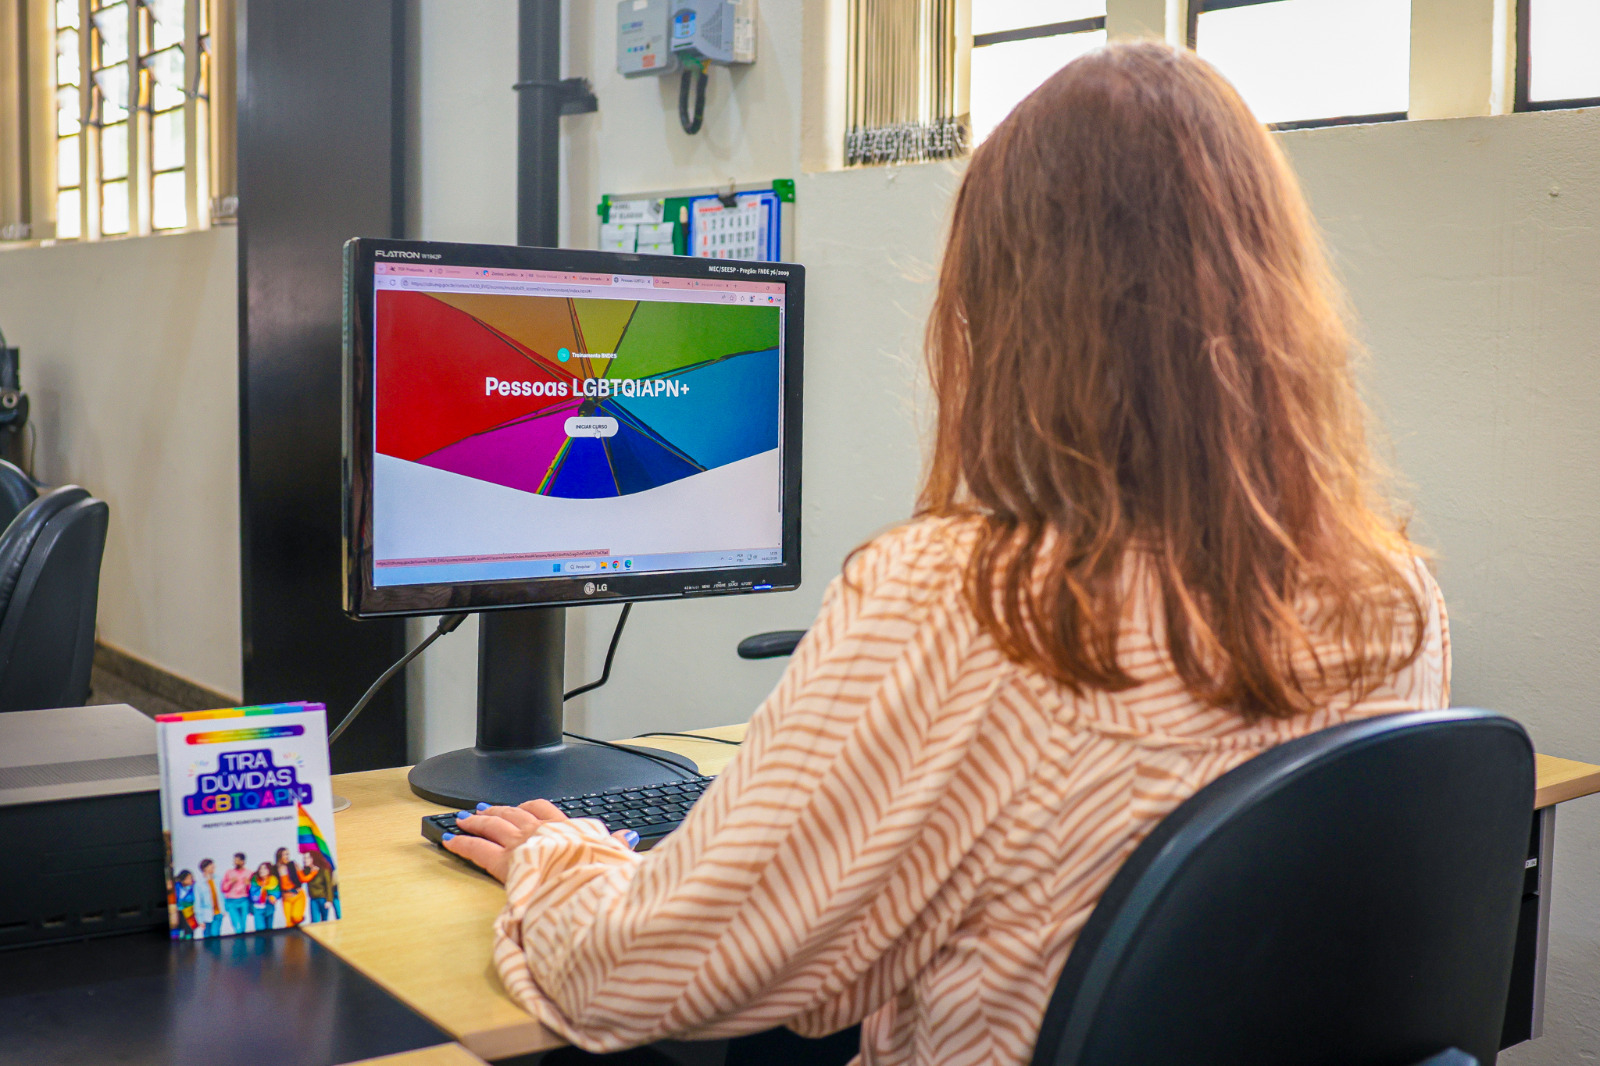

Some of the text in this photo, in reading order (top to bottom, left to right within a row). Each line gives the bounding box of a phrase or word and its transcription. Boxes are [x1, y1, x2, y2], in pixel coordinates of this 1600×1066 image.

[375, 250, 420, 259] FLATRON
[708, 265, 736, 273] MEC/SEESP
[769, 269, 790, 277] 76/2009
[485, 377, 690, 398] Pessoas LGBTQIAPN+
[596, 584, 608, 592] LG
[223, 752, 268, 771] TIRA
